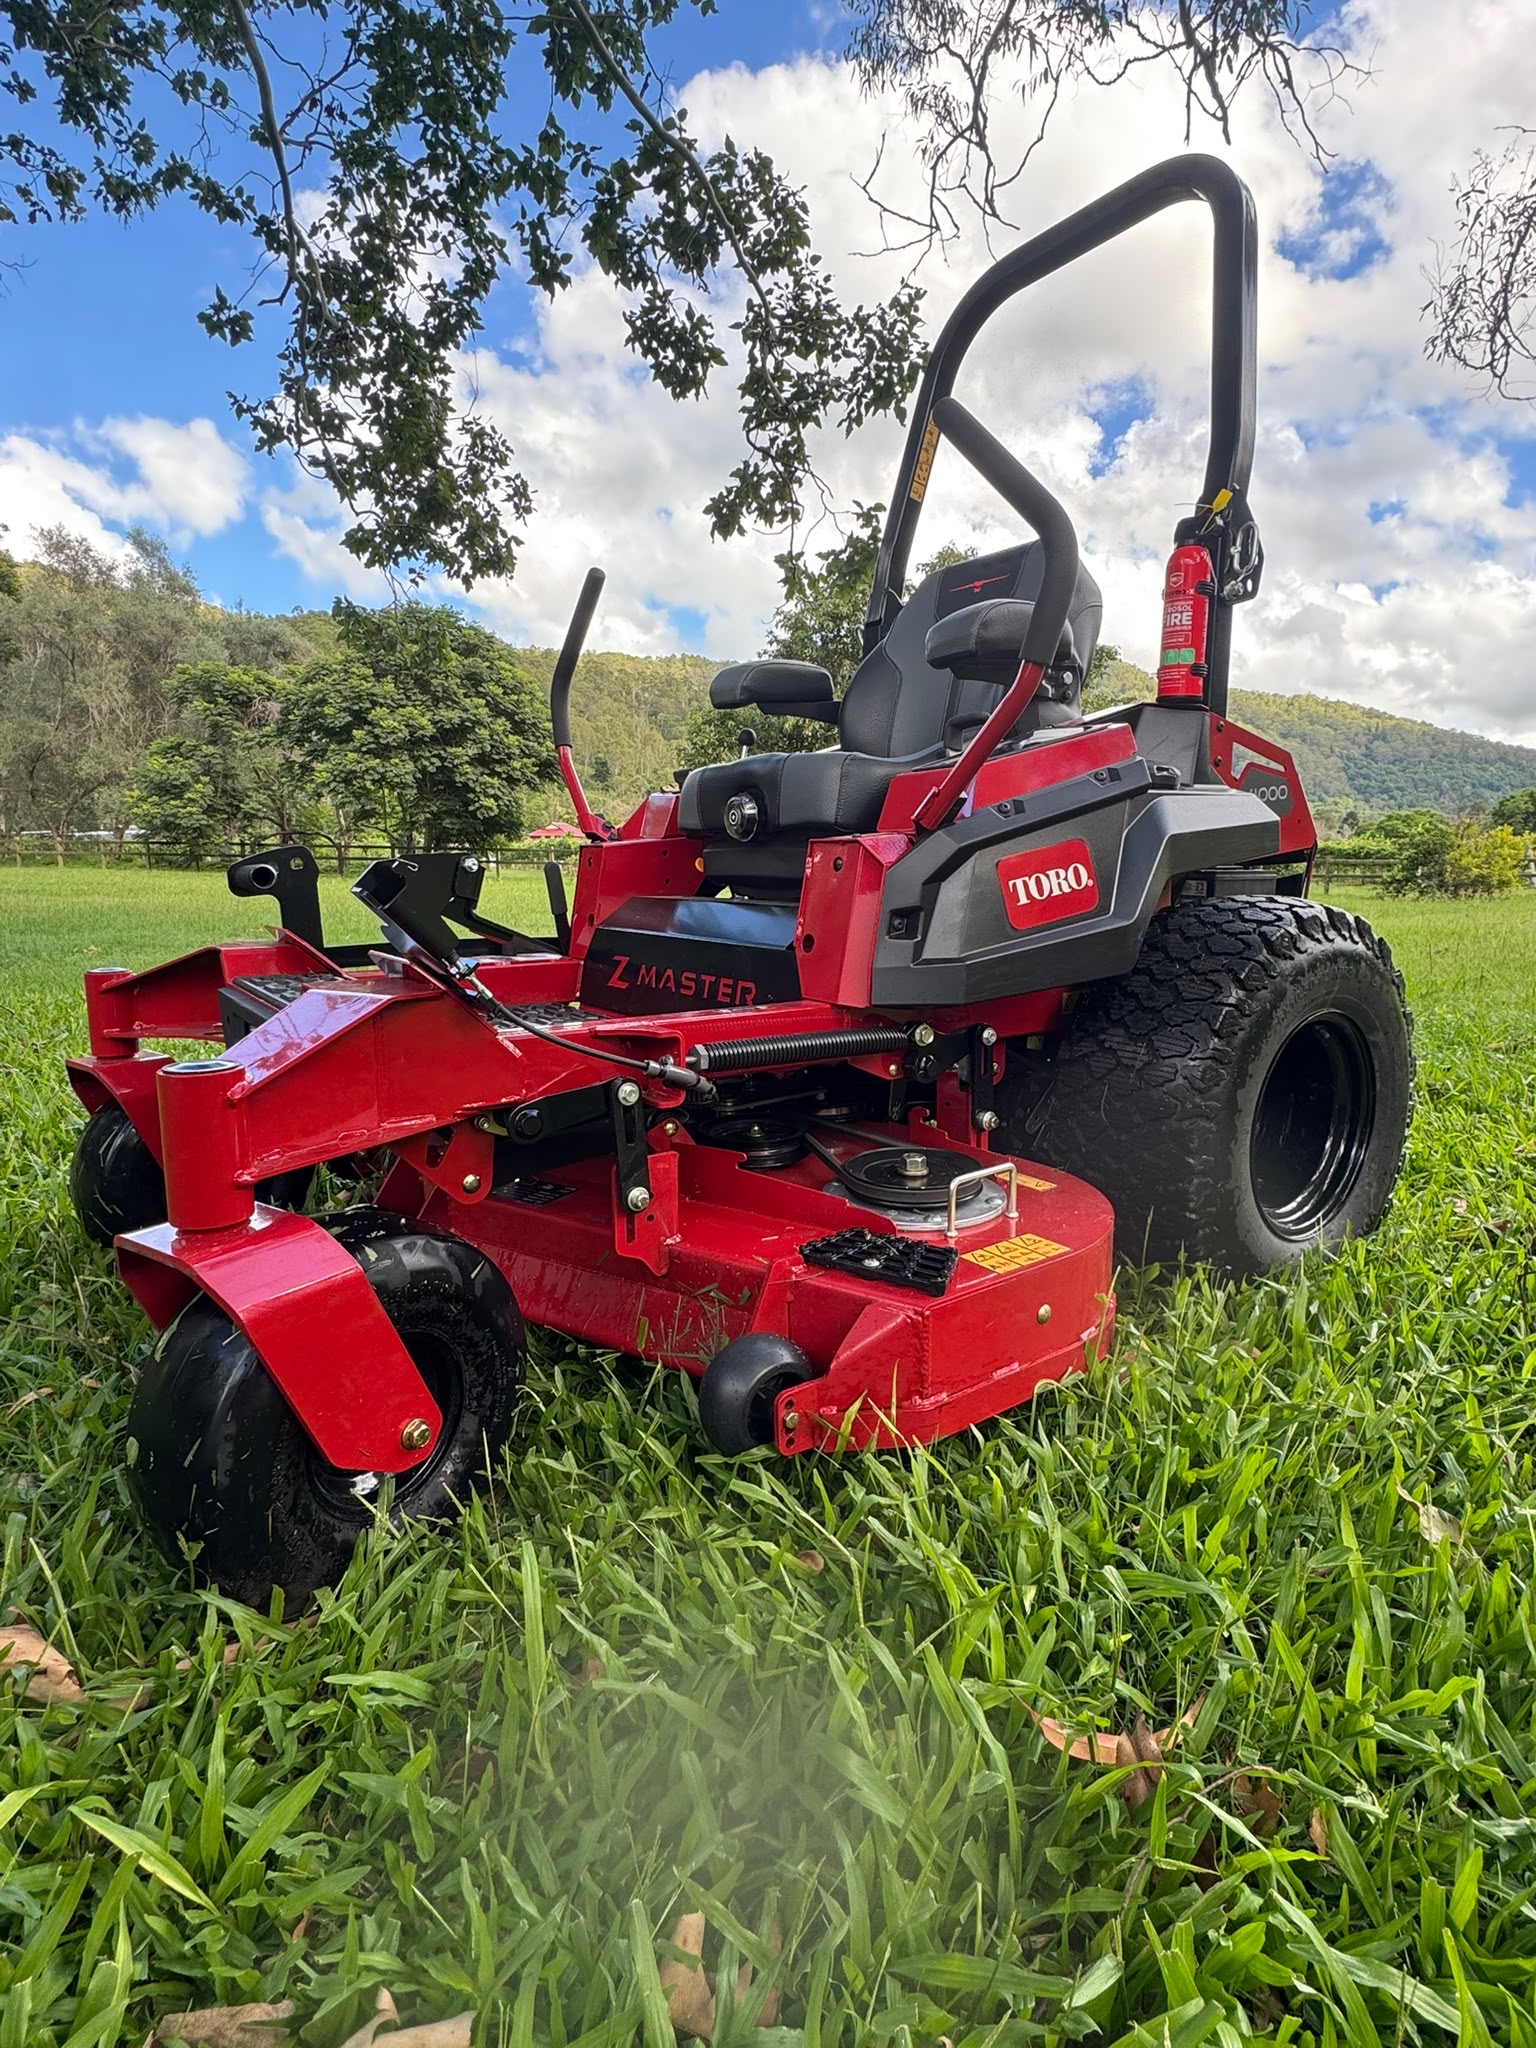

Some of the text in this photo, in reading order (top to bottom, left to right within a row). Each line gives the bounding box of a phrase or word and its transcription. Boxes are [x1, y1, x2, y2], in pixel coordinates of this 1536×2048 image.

[1249, 785, 1288, 801] 000
[608, 954, 757, 1007] Z MASTER
